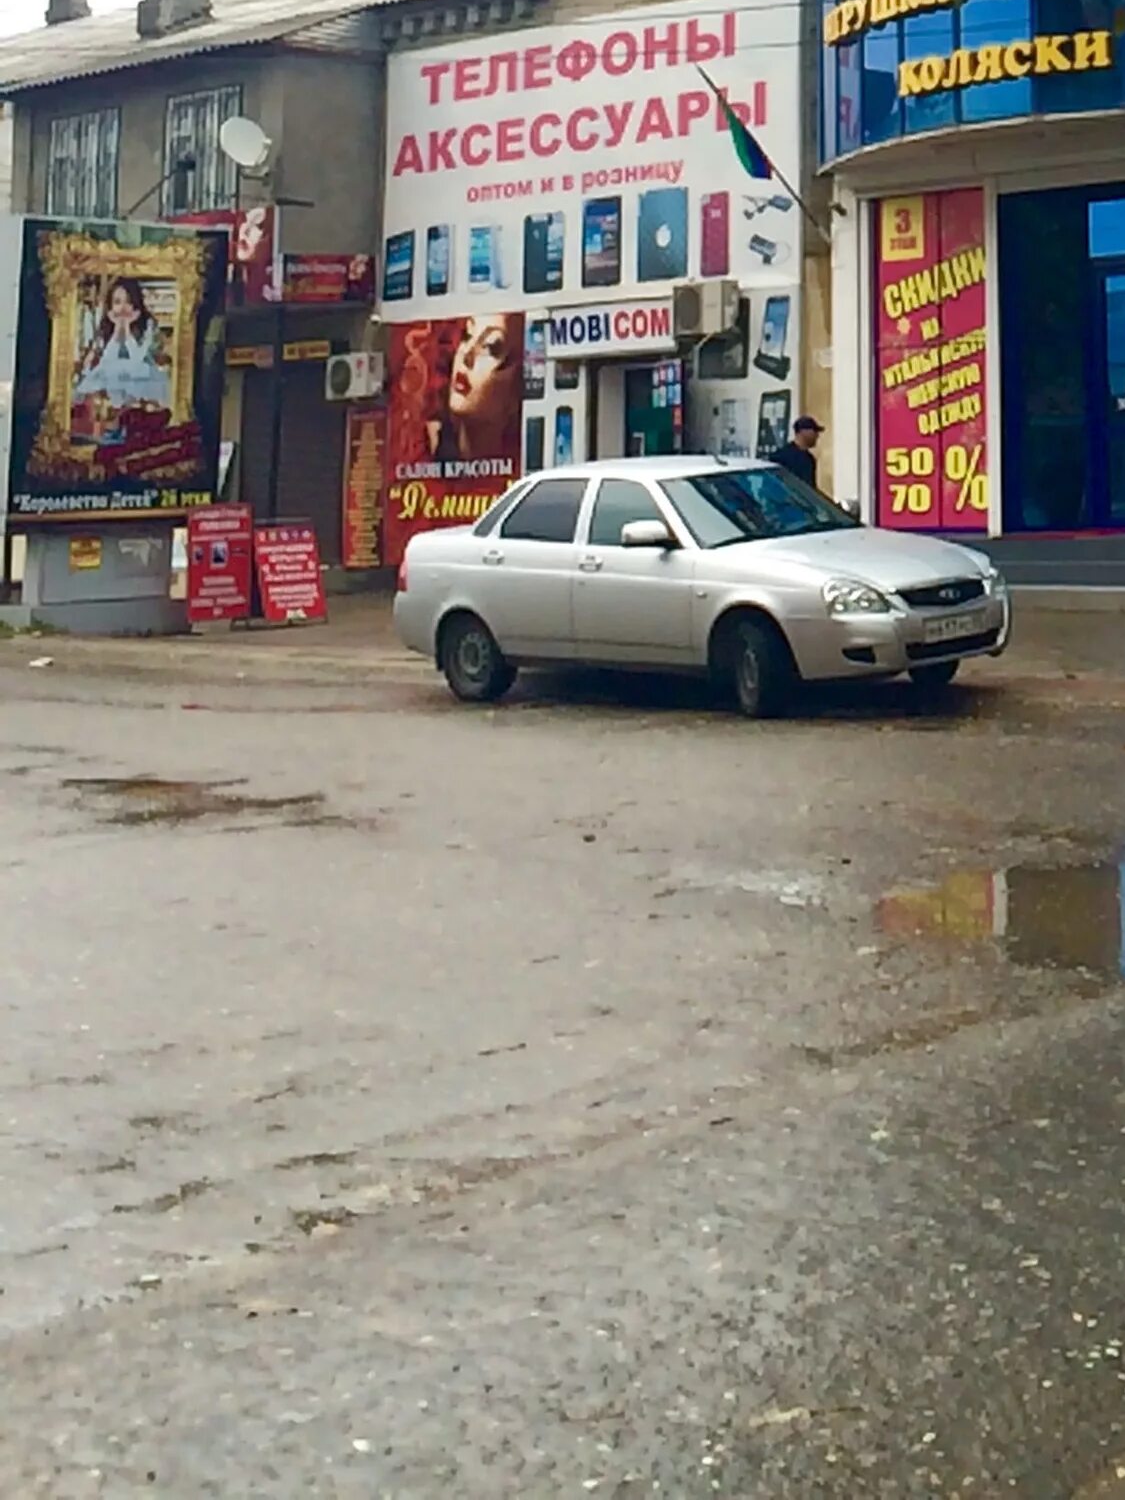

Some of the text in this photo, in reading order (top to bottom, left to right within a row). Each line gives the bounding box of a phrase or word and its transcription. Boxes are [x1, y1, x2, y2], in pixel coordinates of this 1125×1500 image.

[421, 12, 737, 105] ТЕЛЕФОНЫ
[899, 31, 1112, 96] КОЛЯСКИ
[392, 82, 767, 177] АКСЕССУАРЫ
[467, 160, 684, 202] оптом и в розницу
[894, 208, 911, 234] 3
[884, 247, 986, 319] СКИДКИ
[550, 308, 670, 345] MOBICOM
[445, 457, 513, 478] КРАСОТЫ
[886, 446, 934, 476] 50
[889, 483, 932, 513] 70
